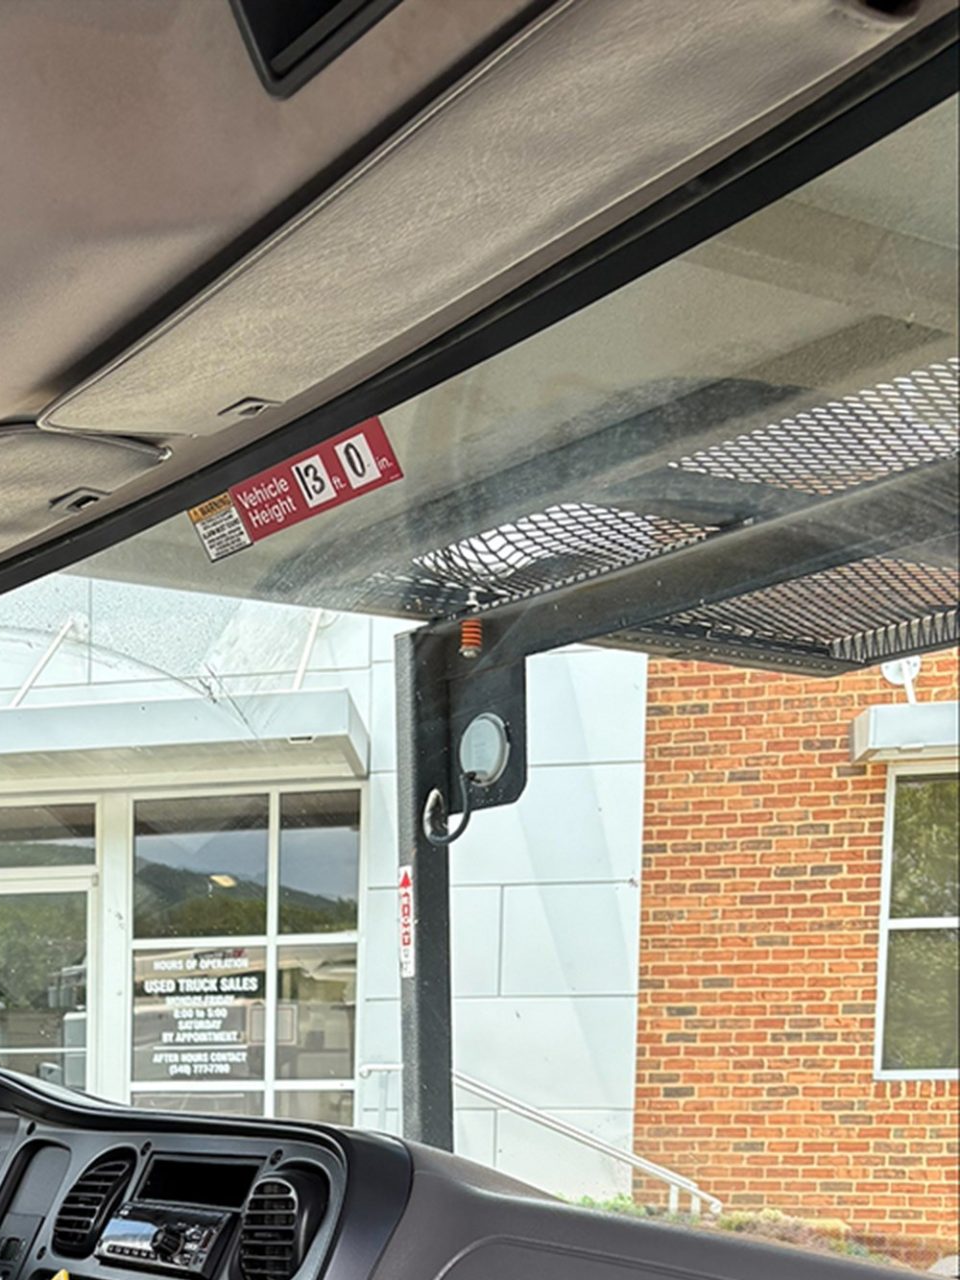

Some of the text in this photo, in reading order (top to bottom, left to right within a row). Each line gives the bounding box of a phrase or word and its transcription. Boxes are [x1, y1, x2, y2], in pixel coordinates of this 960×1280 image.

[295, 442, 393, 500] 13 ft. 0 in.
[237, 477, 289, 510] Vehicle
[248, 497, 297, 529] Height
[153, 958, 248, 970] HOURS OF OPERATION
[144, 976, 258, 994] USED TRUCK SALES
[177, 1019, 222, 1030] SATURDAY
[162, 1032, 174, 1043] BY
[153, 1052, 247, 1063] AFTER HOURS CONTACT
